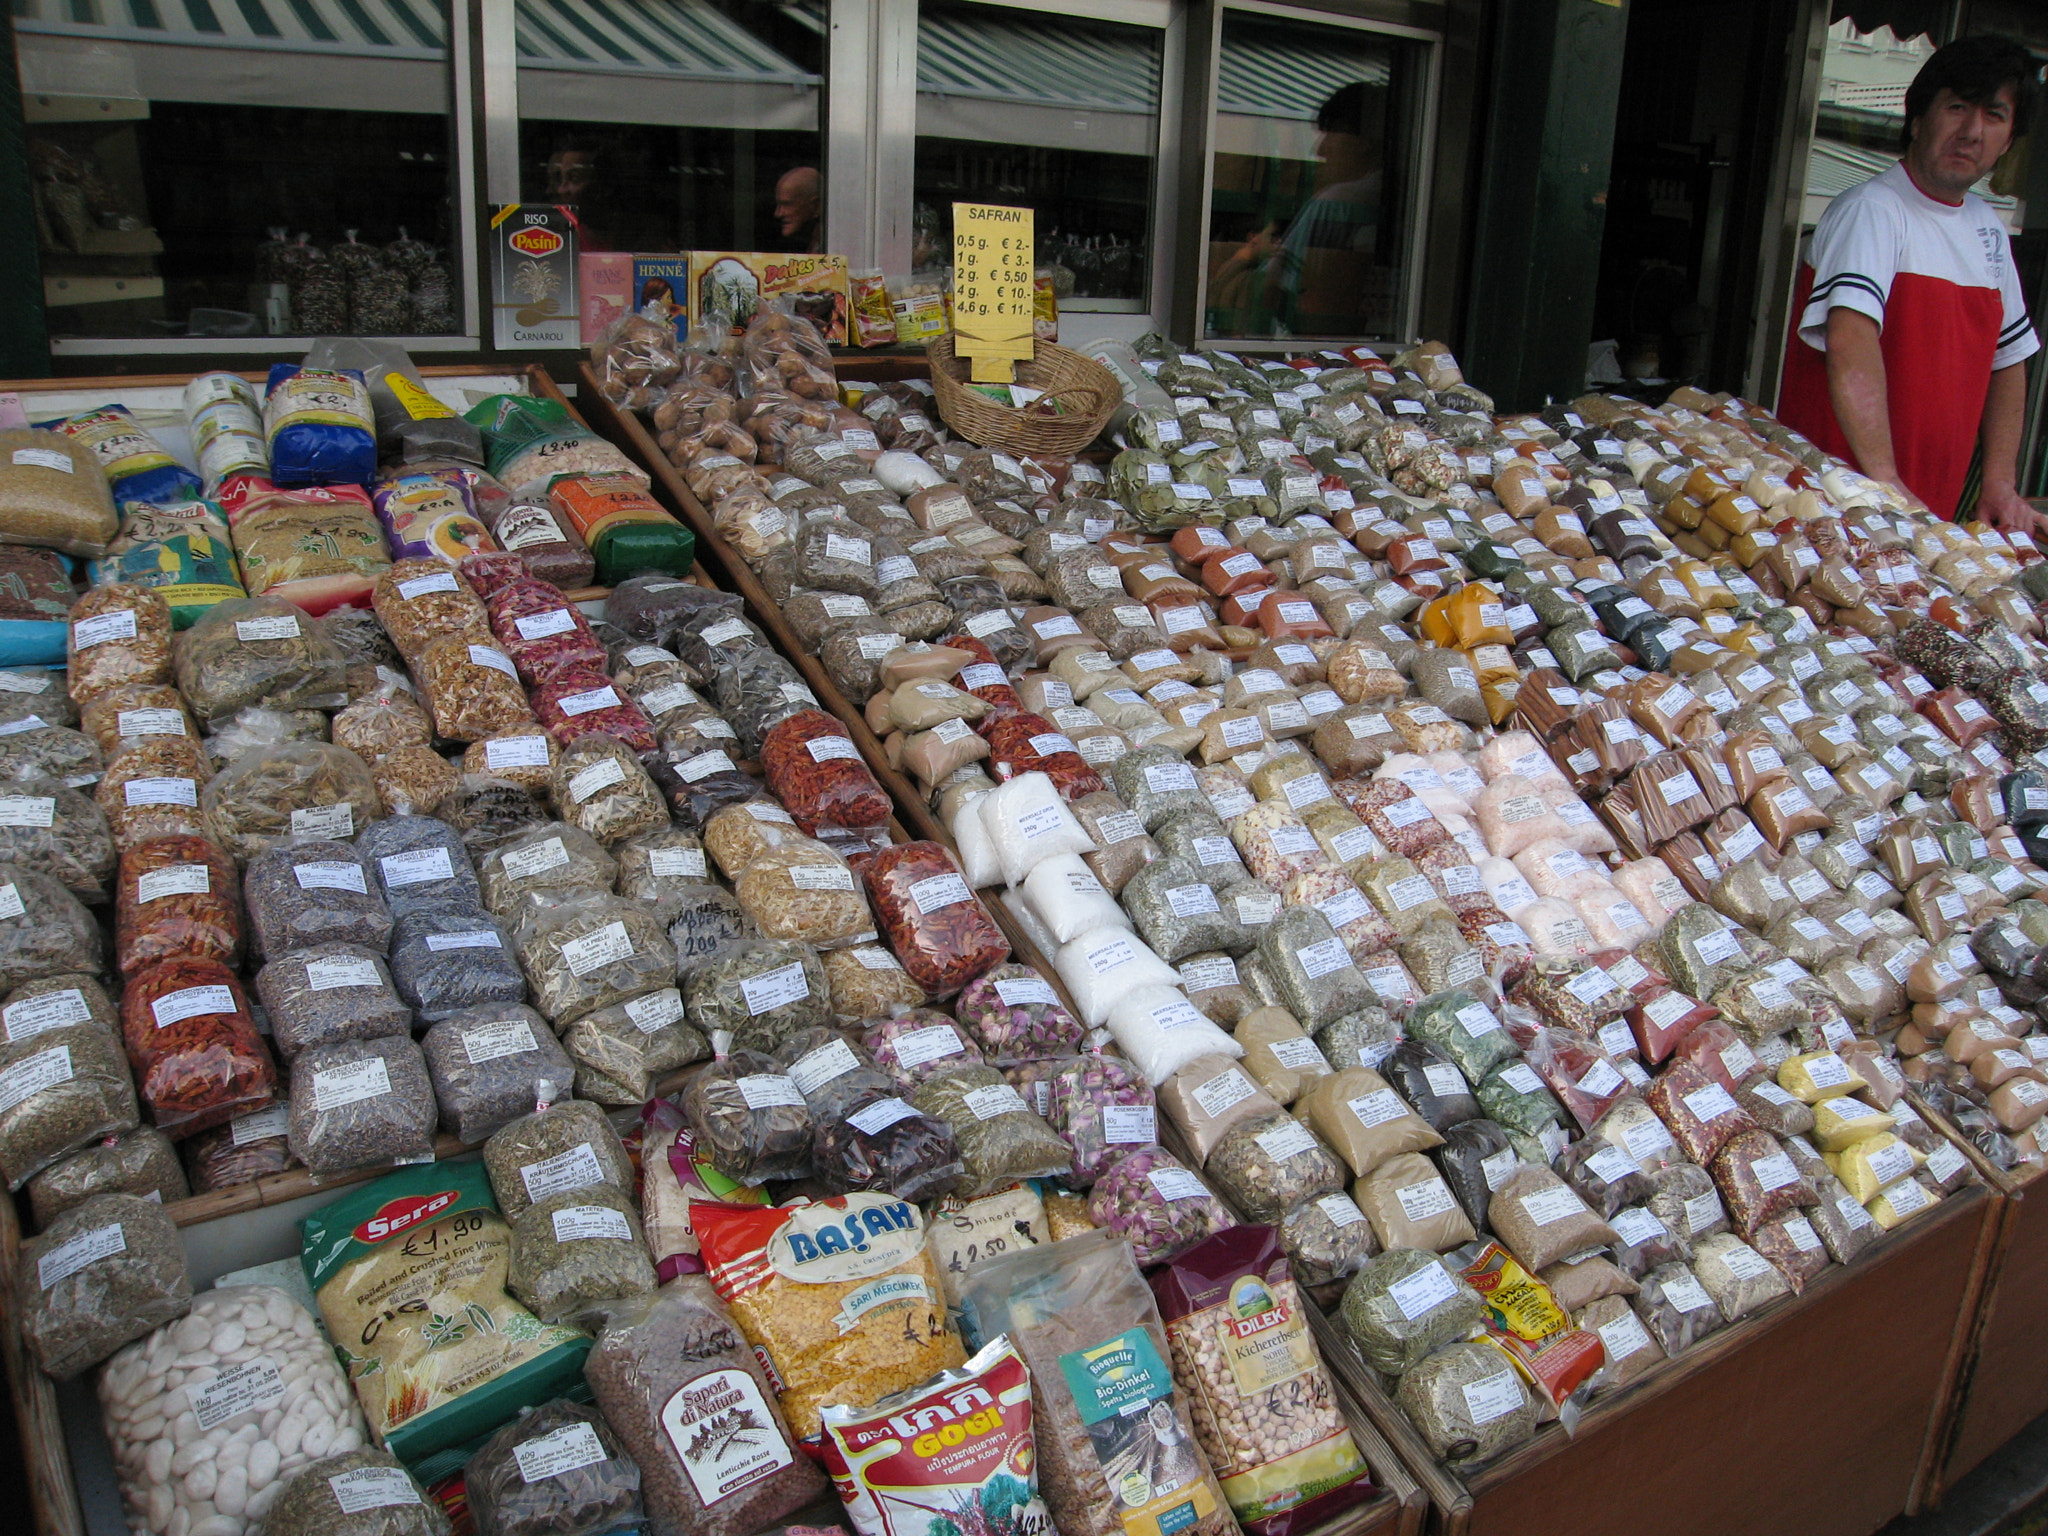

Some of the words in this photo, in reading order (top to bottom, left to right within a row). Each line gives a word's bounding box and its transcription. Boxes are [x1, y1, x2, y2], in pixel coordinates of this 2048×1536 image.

[524, 213, 548, 225] RISO
[968, 207, 1022, 223] SAFRAN
[516, 234, 558, 250] Pasini
[956, 234, 975, 248] 0,5
[978, 238, 989, 250] g.
[1001, 238, 1010, 249] €
[1015, 239, 1030, 250] 2.-
[639, 262, 684, 277] HENNÉ
[957, 251, 964, 263] 1
[967, 254, 979, 266] g.
[1001, 254, 1010, 265] €
[1015, 255, 1030, 267] 3.-
[764, 258, 815, 284] Dattes
[957, 268, 965, 279] 2
[967, 271, 979, 282] g.
[990, 269, 998, 281] €
[1003, 270, 1028, 284] 5,50
[957, 284, 965, 296] 4
[967, 287, 979, 299] g.
[996, 286, 1005, 298] €
[1011, 287, 1031, 299] 10.-
[957, 301, 976, 313] 4,6
[978, 304, 990, 316] g.
[997, 303, 1005, 314] €
[1011, 304, 1031, 315] 11.-
[513, 330, 564, 342] CARNAROLI
[685, 934, 717, 957] 20g
[529, 1152, 589, 1178] KRÄUTERMISCHUNG
[536, 1149, 577, 1169] ITALIENISCHE
[528, 1177, 542, 1186] 50g
[367, 1194, 449, 1240] Sera
[784, 1201, 917, 1266] BAŞAK
[388, 1269, 408, 1285] and
[409, 1252, 451, 1275] Crushed
[452, 1244, 474, 1259] Fine
[850, 1292, 872, 1311] SARI
[872, 1280, 923, 1302] MERCİMEK
[1239, 1307, 1287, 1337] DILEK
[1235, 1328, 1302, 1360] Kichererbsen
[1263, 1346, 1290, 1362] NOHUT
[216, 1363, 245, 1381] WEISSE
[1089, 1350, 1134, 1375] Bioquelle
[204, 1364, 261, 1395] RIESENBOHNEN
[1095, 1368, 1151, 1399] Bio-Dinkel
[195, 1396, 212, 1408] 1kg
[681, 1375, 732, 1408] Sapori
[1101, 1395, 1123, 1409] Spelta
[1123, 1382, 1156, 1401] biologica
[680, 1409, 698, 1427] di
[697, 1388, 746, 1420] Natura
[559, 1424, 581, 1435] SENNA
[857, 1426, 893, 1445] ตรา
[912, 1406, 1004, 1458] GOGI
[519, 1451, 536, 1461] 40g
[926, 1432, 1008, 1473] แป้งประกอบอาหาร
[943, 1458, 977, 1477] TEMPURA
[977, 1446, 1000, 1461] FLOUR
[716, 1458, 751, 1480] Lenticchie
[751, 1449, 771, 1462] Rosse
[337, 1487, 353, 1496] 50g
